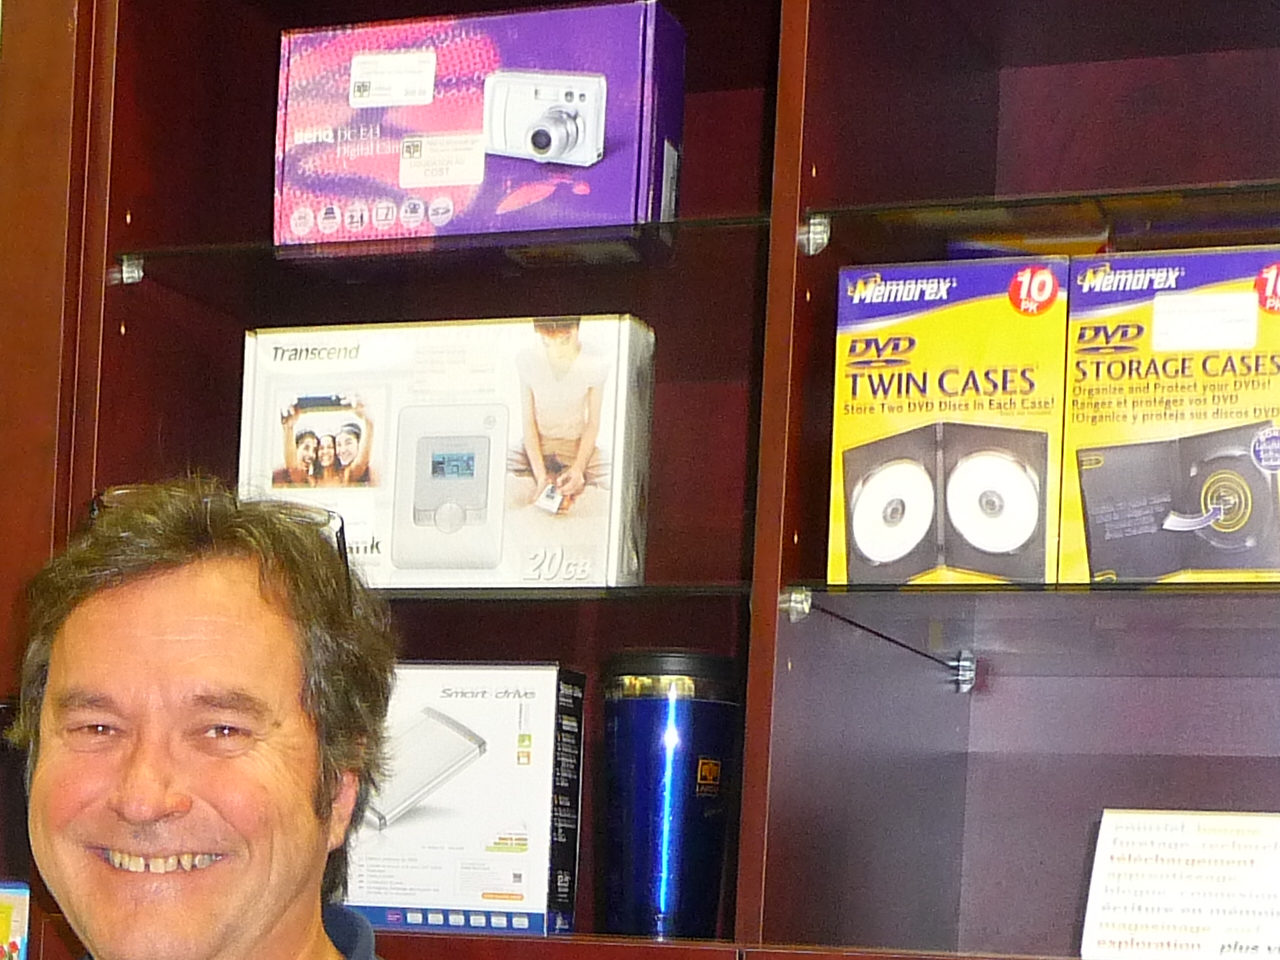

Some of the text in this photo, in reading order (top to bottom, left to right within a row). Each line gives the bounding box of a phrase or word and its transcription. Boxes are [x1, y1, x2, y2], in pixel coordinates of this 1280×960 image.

[1017, 268, 1053, 302] 10
[1077, 262, 1180, 293] Memorex
[848, 273, 952, 304] Memorex
[1020, 301, 1039, 314] PK
[1077, 323, 1144, 345] DVD
[272, 344, 360, 361] Transcend
[847, 336, 916, 360] DVD
[1075, 354, 1280, 383] STORAGE CASES
[846, 368, 1036, 400] TWIN CASES
[1073, 383, 1124, 397] Organize
[1129, 382, 1150, 394] and
[1154, 381, 1198, 394] Protect
[1202, 382, 1230, 394] your
[844, 403, 875, 416] Store
[881, 402, 903, 414] Two
[908, 400, 934, 412] DVD
[939, 400, 969, 412] Discs
[989, 398, 1017, 411] Each
[1021, 396, 1055, 410] Case!
[1117, 397, 1128, 409] et
[1189, 396, 1208, 406] vos
[1212, 393, 1239, 405] DVD
[1132, 412, 1138, 424] y
[1190, 409, 1208, 420] sus
[1212, 406, 1249, 419] discos
[1253, 406, 1280, 419] DVD
[439, 687, 537, 700] Smart drive
[1220, 941, 1260, 956] plus
